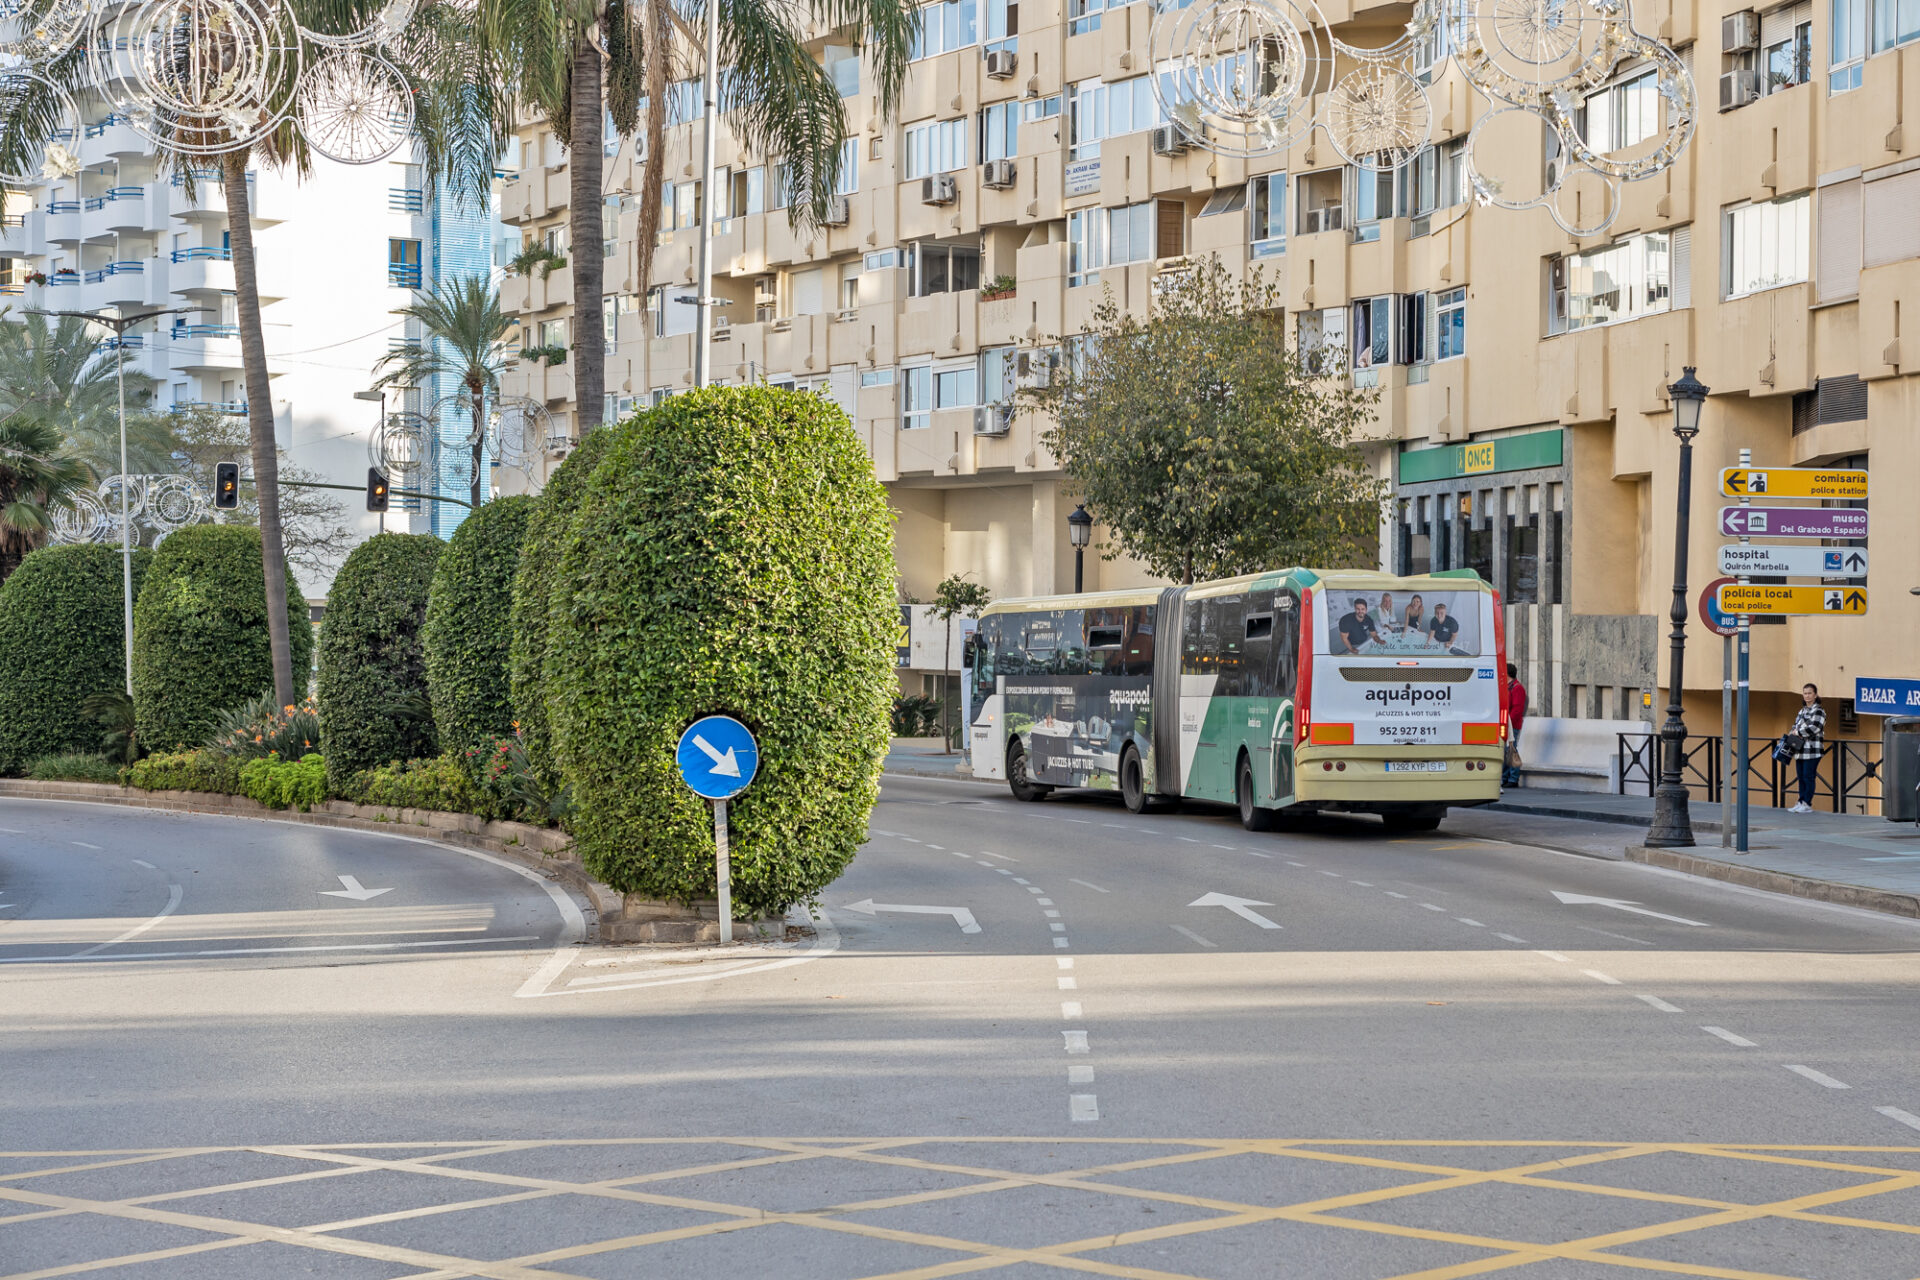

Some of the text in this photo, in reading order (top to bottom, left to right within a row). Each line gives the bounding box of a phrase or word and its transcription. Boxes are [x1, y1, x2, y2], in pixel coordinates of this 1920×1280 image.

[1073, 165, 1088, 173] AKRAM
[1468, 447, 1491, 467] ONCE
[1814, 473, 1866, 484] comisaría
[1810, 487, 1867, 496] police station
[1832, 514, 1866, 524] museo
[1780, 525, 1866, 536] Del Grabado Español
[1724, 549, 1770, 562] hospital
[1724, 562, 1790, 571] Quirón Marbella
[1724, 588, 1793, 601] policía local
[1724, 601, 1772, 611] local police
[1721, 617, 1735, 626] BUS
[1109, 684, 1150, 712] aquapool
[1365, 686, 1451, 706] aquapool
[1861, 688, 1896, 704] BAZAR
[1380, 727, 1437, 736] 952 927 811
[1072, 758, 1082, 769] HOT
[1082, 758, 1094, 770] TUBS
[1392, 763, 1410, 771] 1292
[1411, 762, 1425, 771] KYP
